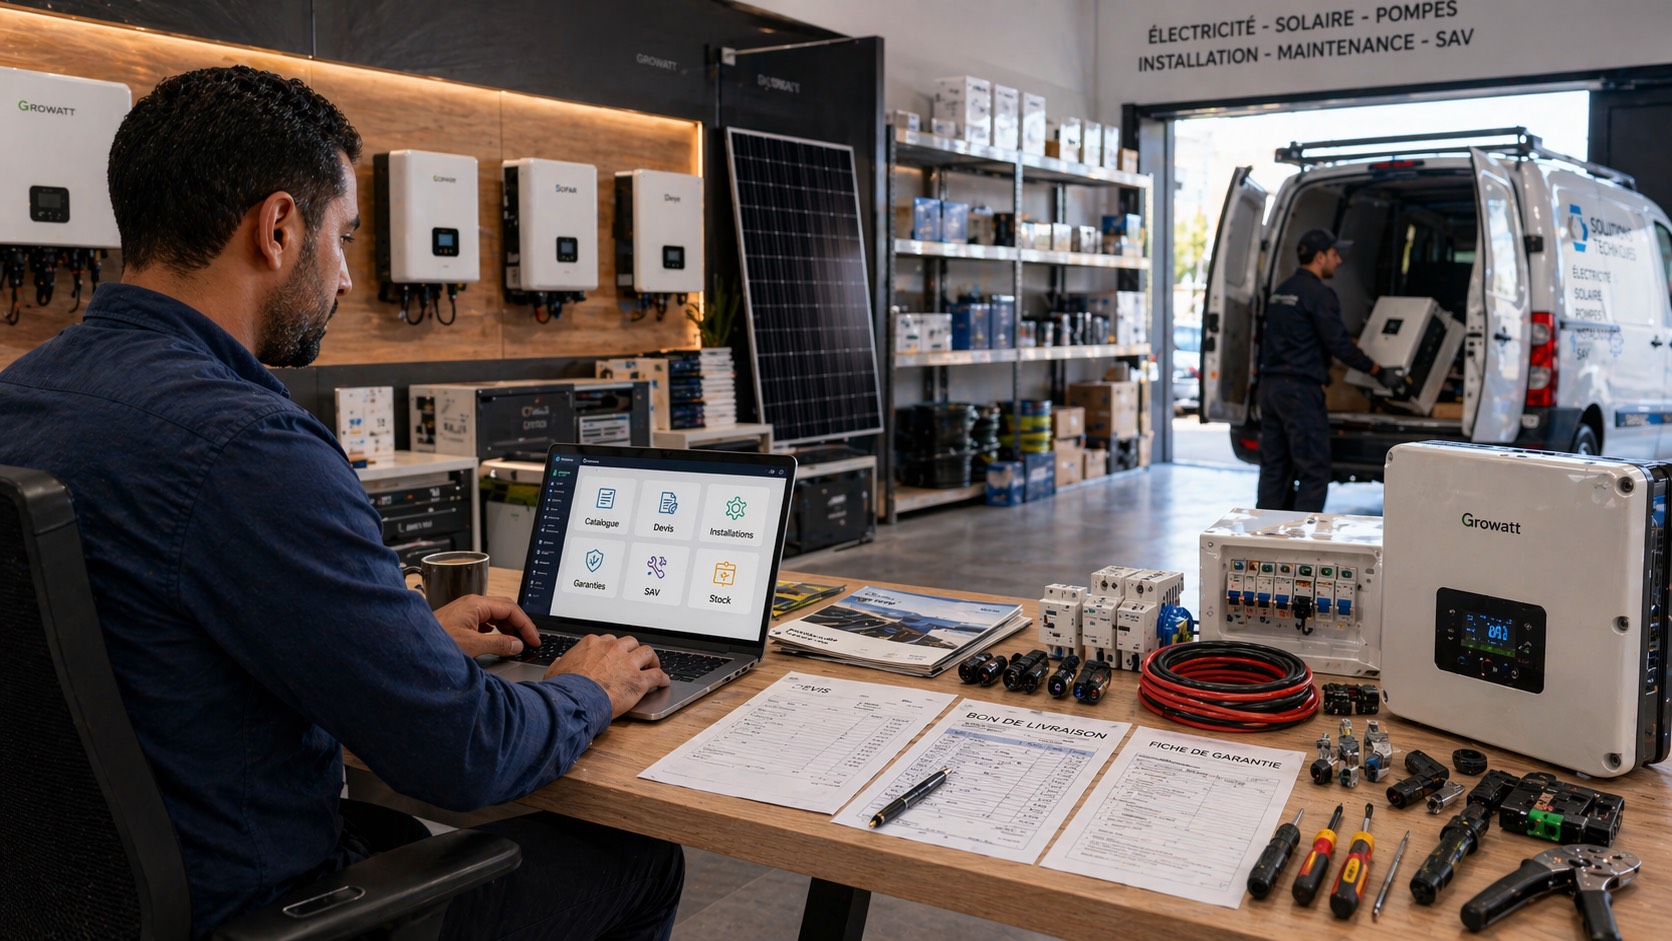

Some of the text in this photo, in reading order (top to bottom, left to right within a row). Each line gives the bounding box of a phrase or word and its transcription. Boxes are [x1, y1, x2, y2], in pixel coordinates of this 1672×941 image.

[1148, 15, 1256, 45] ÉLECTRICITÉ
[1275, 9, 1355, 33] SOLAIRE
[1376, 0, 1458, 24] POMPES
[1138, 46, 1259, 72] INSTALLATION
[1277, 33, 1415, 61] MAINTENANCE
[1435, 28, 1475, 48] SAV
[636, 53, 677, 71] GROWATT
[18, 100, 76, 116] GROWATT
[584, 517, 620, 529] Catalogue
[653, 523, 674, 533] Devis
[1461, 512, 1521, 535] Growatt
[709, 527, 754, 540] Installations
[573, 579, 606, 591] Garanties
[644, 587, 661, 597] SAV
[709, 594, 732, 605] Stock
[965, 712, 1108, 740] BON DE LIVRAISON
[1148, 740, 1189, 753] FICHE
[1190, 748, 1210, 757] DE
[1212, 752, 1283, 769] GARANTIE
